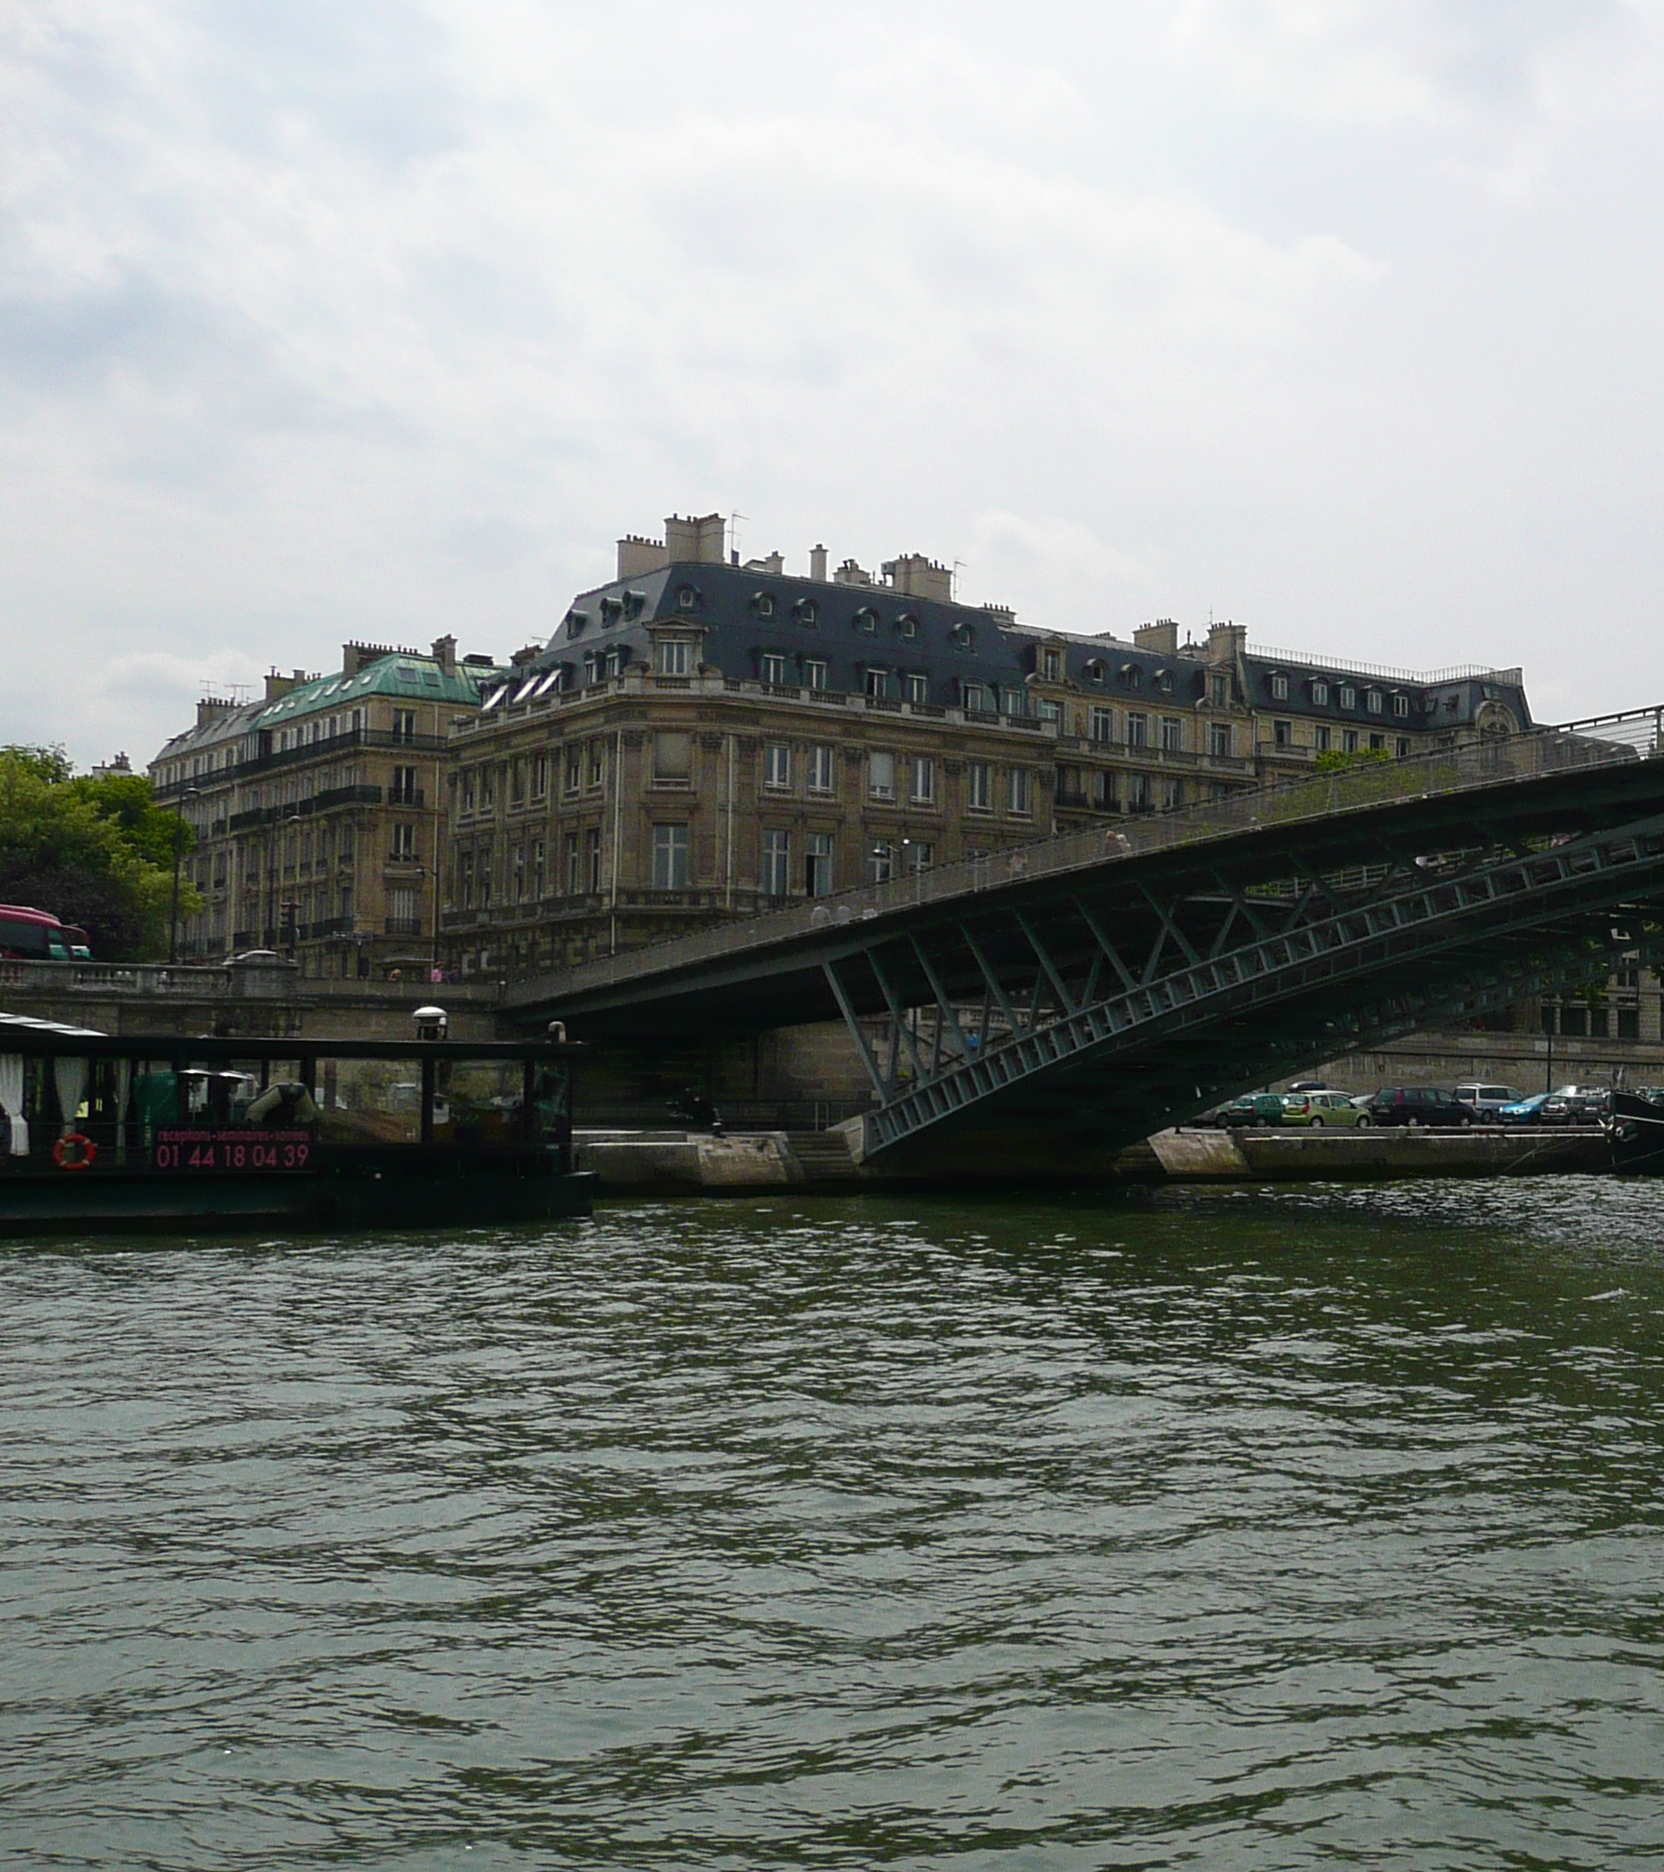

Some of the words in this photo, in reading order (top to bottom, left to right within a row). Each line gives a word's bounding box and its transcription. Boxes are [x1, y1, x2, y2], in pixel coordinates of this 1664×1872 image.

[157, 1145, 179, 1167] 01
[188, 1145, 215, 1167] 44
[224, 1145, 246, 1167] 18
[252, 1145, 277, 1167] 04
[283, 1145, 309, 1167] 39
